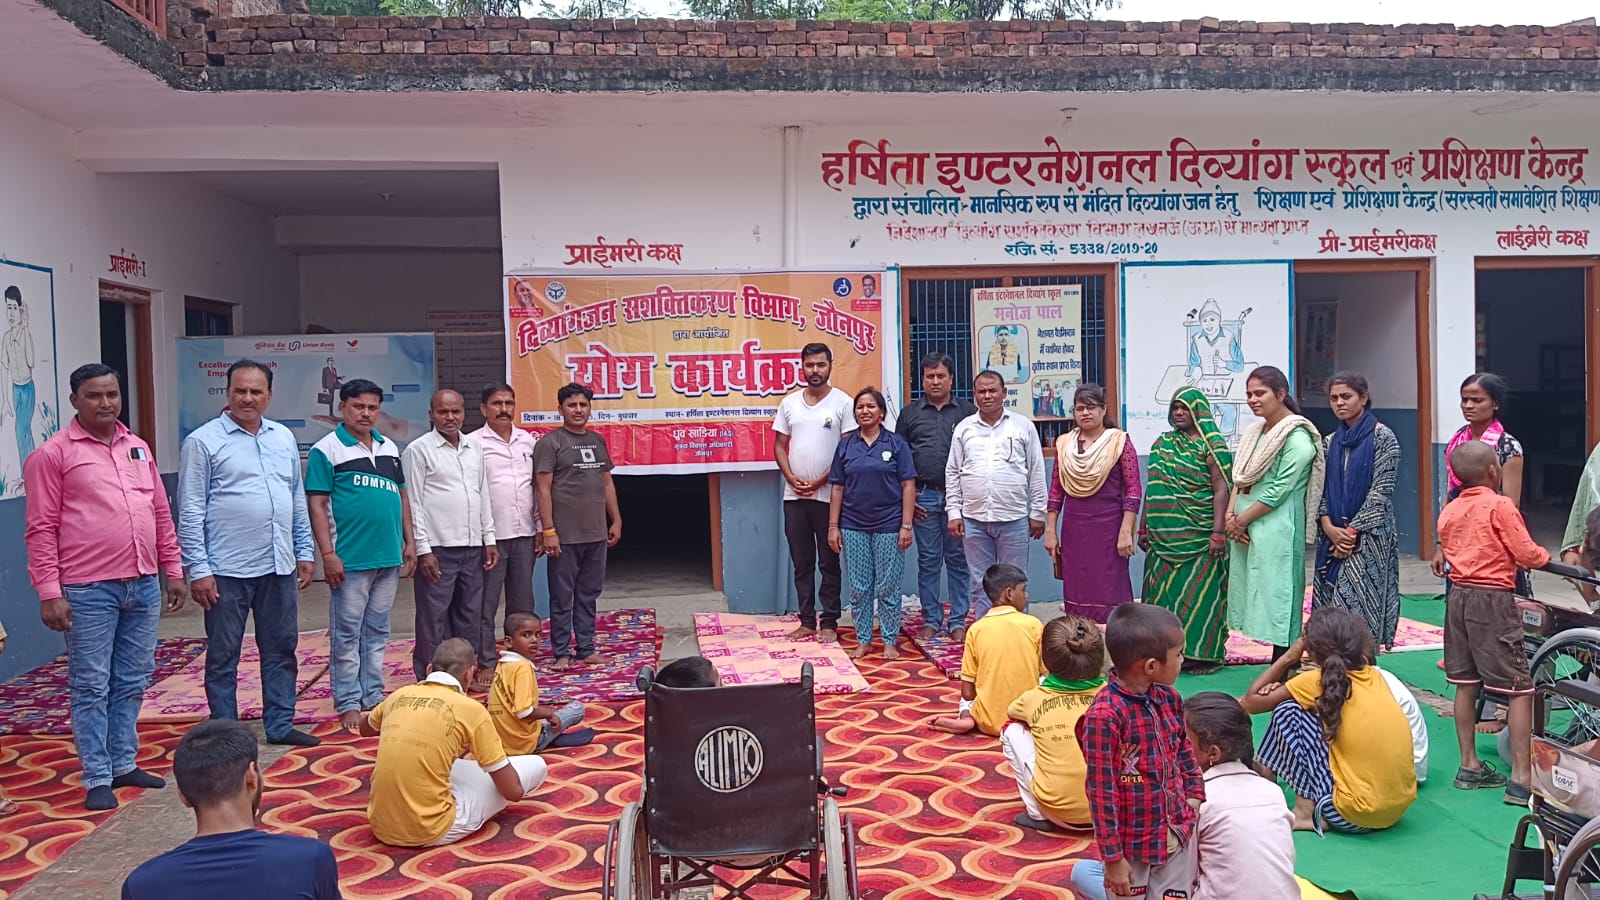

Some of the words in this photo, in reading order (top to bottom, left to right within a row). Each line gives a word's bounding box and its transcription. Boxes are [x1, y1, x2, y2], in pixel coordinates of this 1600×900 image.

[821, 139, 930, 191] हर्षिता
[935, 136, 1162, 193] इण्टरनेशनल
[1167, 137, 1299, 188] दिव्यांग
[1304, 149, 1390, 190] स्कूल
[1391, 151, 1415, 178] एवं
[1418, 137, 1525, 187] प्रशिक्षण
[1527, 136, 1589, 185] केन्द्र
[852, 197, 889, 220] द्वारा
[969, 189, 1034, 214] मानसिक
[1063, 187, 1079, 213] से
[1082, 187, 1123, 215] मंदित
[1126, 187, 1182, 215] दिव्यांग
[1182, 193, 1213, 211] जन
[1215, 185, 1241, 216] हेतु
[1254, 186, 1307, 212] शिक्षण
[1309, 188, 1336, 210] एवं
[1402, 182, 1438, 213] केन्द्र
[1500, 184, 1557, 213] समावेशित
[563, 236, 645, 268] प्राईमरी
[647, 244, 683, 265] कक्ष
[1496, 224, 1552, 250] लाईब्रेरी
[1556, 230, 1590, 249] कक्ष
[517, 303, 618, 356] दिव्यांगजन
[813, 298, 877, 354] जौनपुर
[1036, 305, 1063, 319] पाल
[566, 343, 656, 397] योग
[665, 340, 809, 396] कार्यक्र
